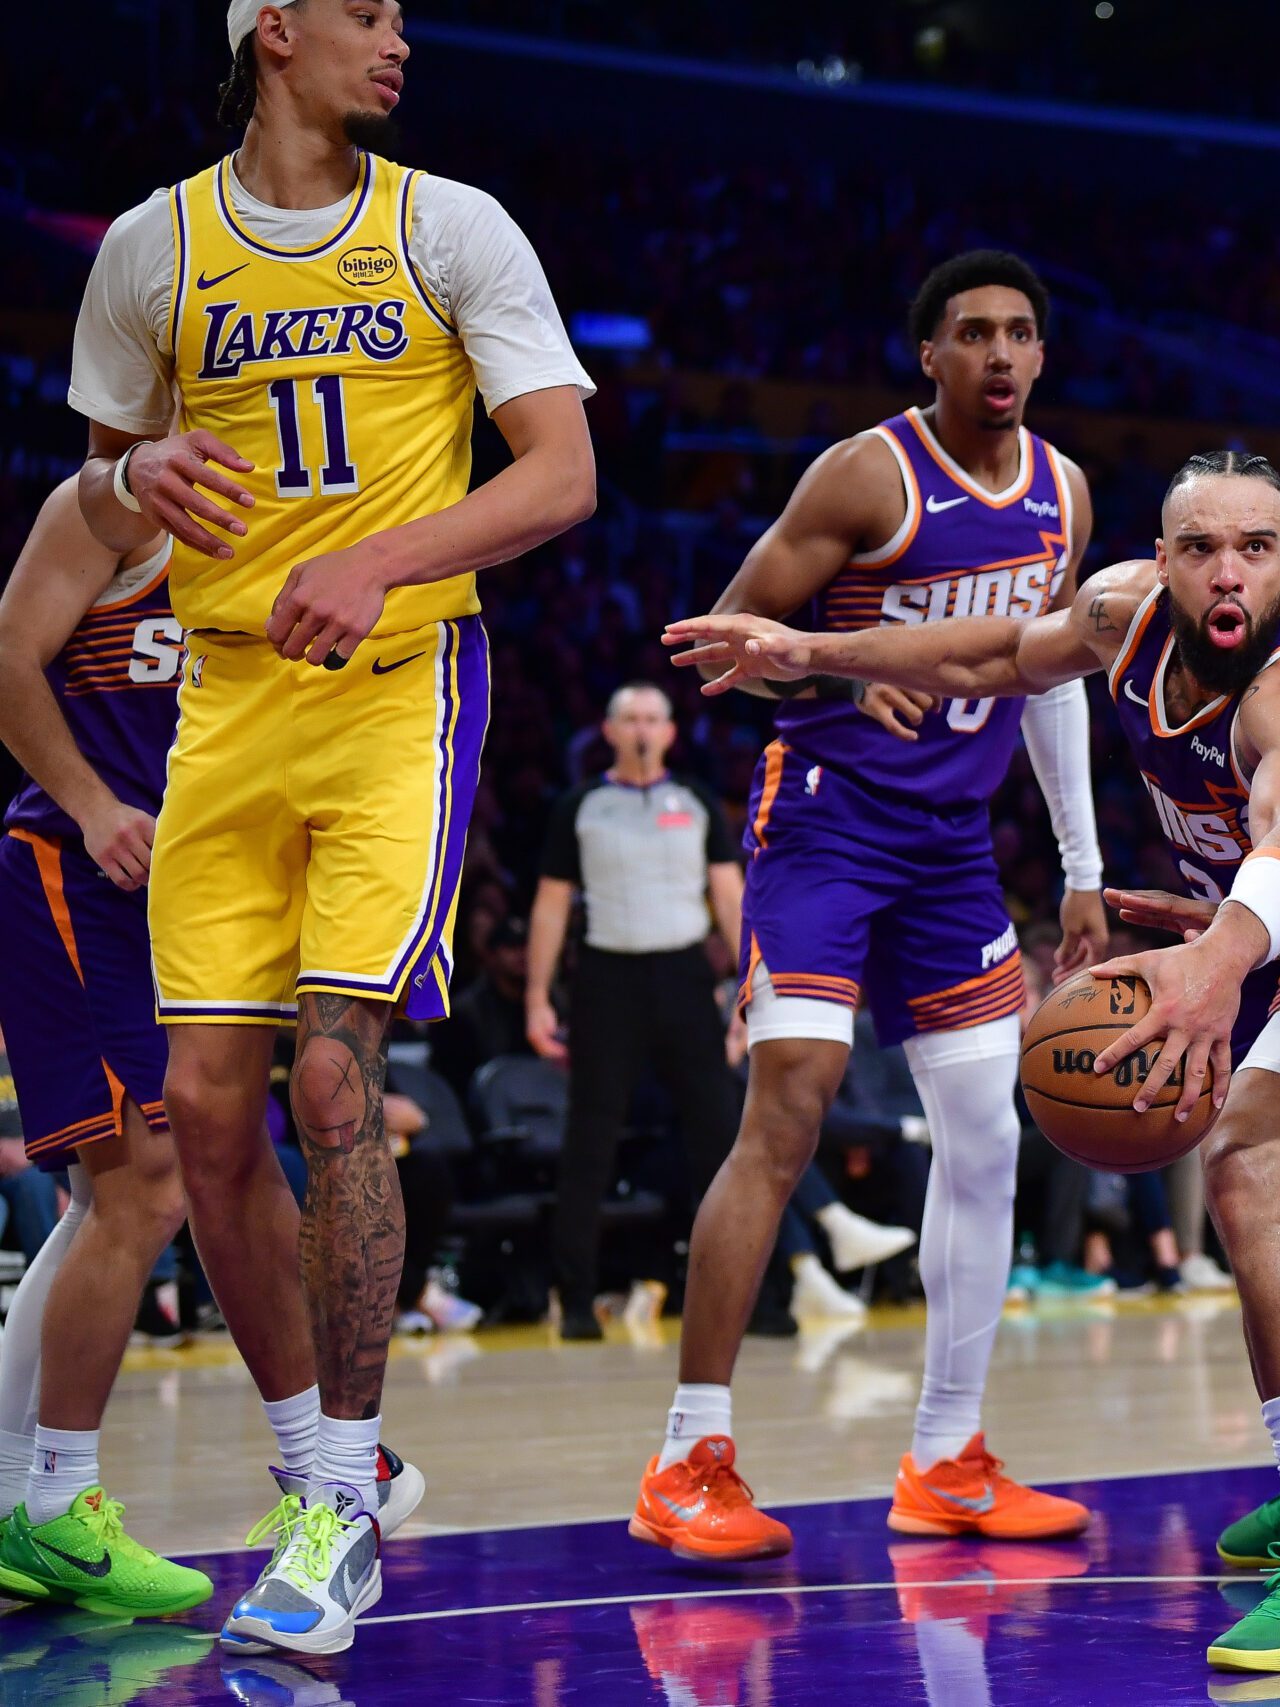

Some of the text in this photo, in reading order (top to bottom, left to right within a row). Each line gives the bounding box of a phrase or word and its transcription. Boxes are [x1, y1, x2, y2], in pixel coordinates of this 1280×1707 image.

[343, 257, 394, 273] bibigo
[197, 301, 411, 380] LAKERS
[267, 375, 359, 498] 11
[1023, 497, 1059, 518] PayPal
[1190, 735, 1225, 768] PayPal
